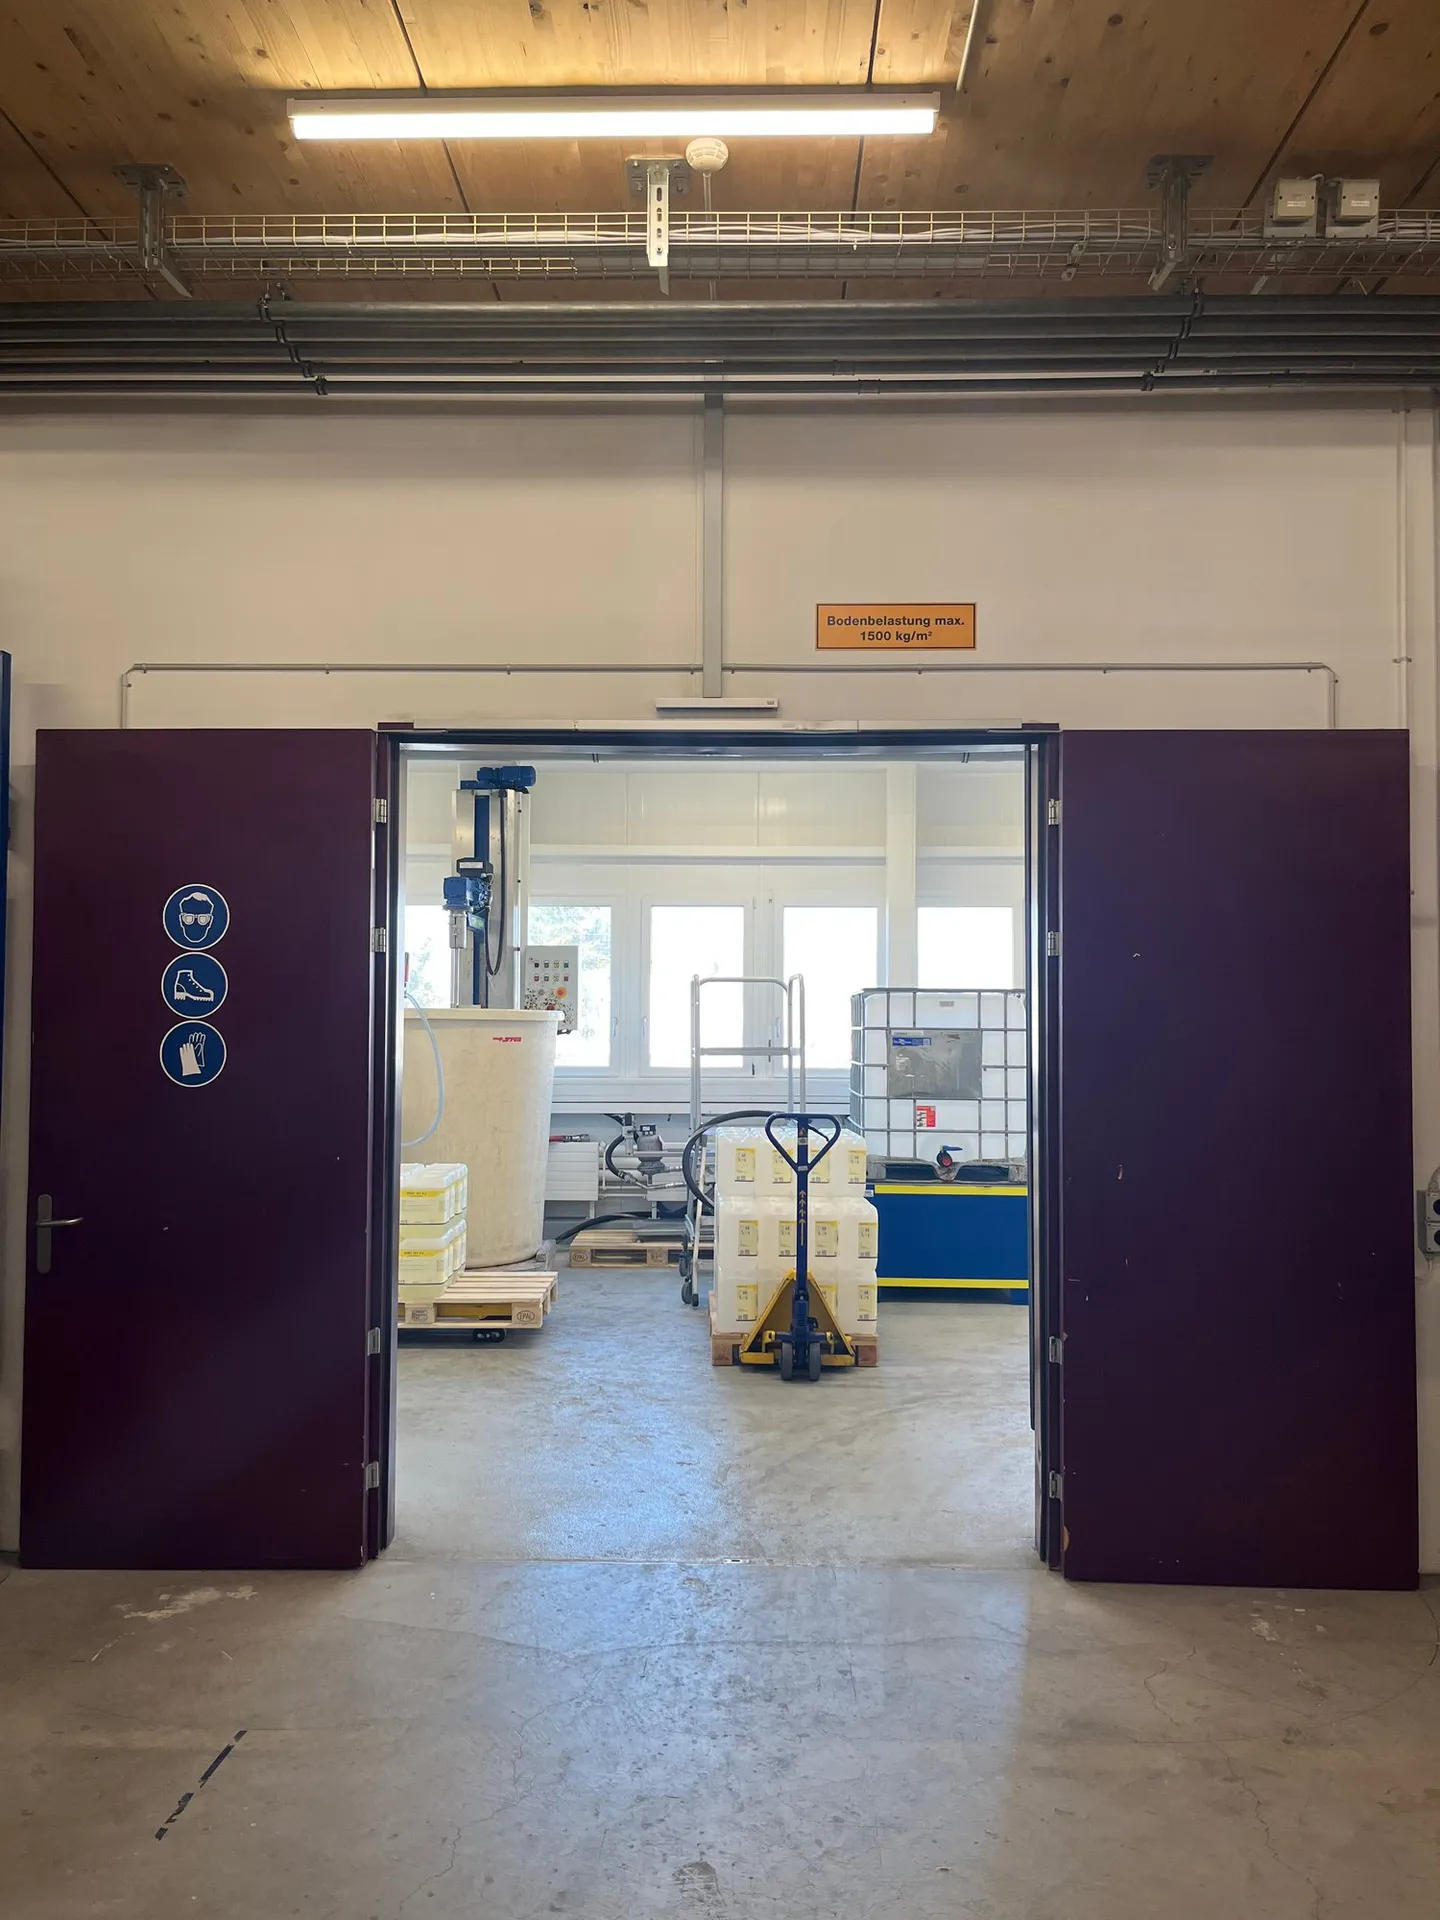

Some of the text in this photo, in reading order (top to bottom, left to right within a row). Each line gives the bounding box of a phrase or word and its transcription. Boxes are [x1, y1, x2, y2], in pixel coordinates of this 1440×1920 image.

[827, 615, 965, 628] Bodenbelastung max.
[860, 630, 933, 643] 1500 kg/m²
